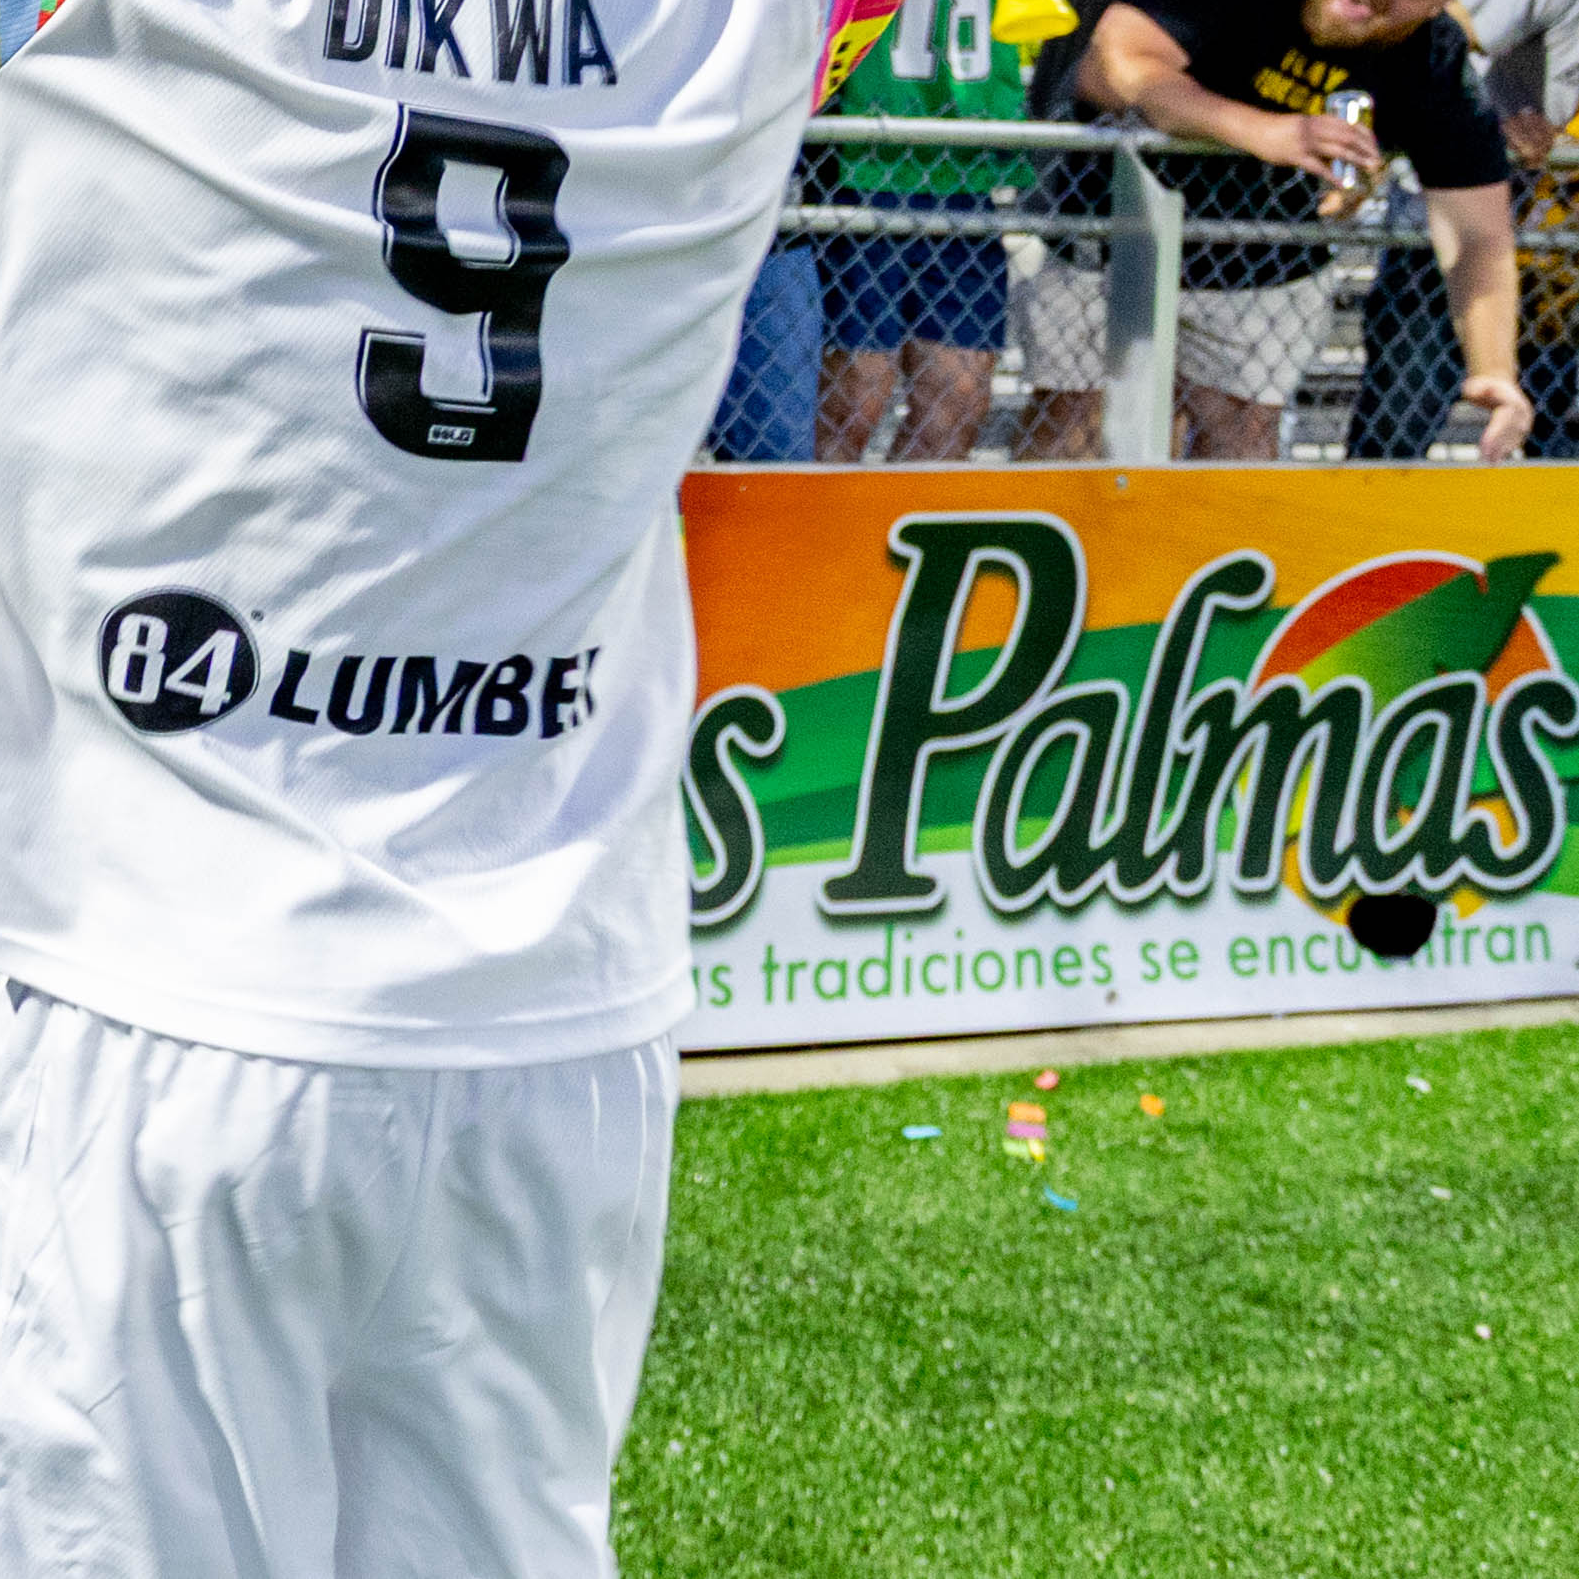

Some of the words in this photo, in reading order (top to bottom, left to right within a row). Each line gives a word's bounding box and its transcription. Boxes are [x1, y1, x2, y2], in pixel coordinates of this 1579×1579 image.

[355, 101, 571, 463] 9
[106, 612, 241, 716] 84
[269, 645, 600, 739] LUMBE
[819, 512, 1579, 912] Palmas
[692, 963, 734, 1009] s
[760, 921, 1114, 1006] tradiciones
[1140, 938, 1200, 983] se
[1228, 911, 1552, 977] encutran
